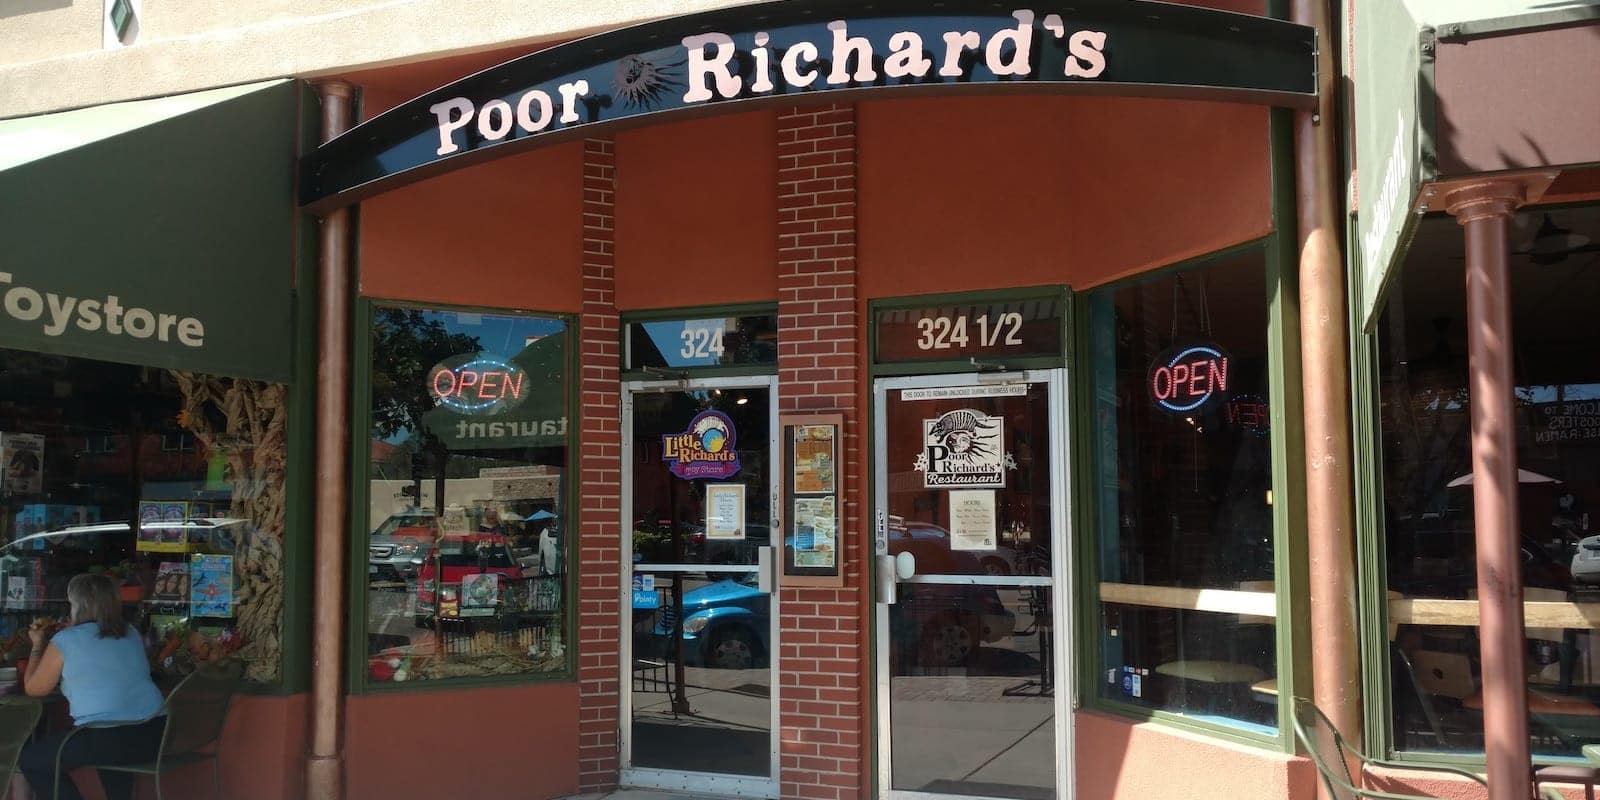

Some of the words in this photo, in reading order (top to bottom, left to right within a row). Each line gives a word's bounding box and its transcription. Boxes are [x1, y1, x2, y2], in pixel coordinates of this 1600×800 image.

[430, 80, 589, 156] Poor
[682, 9, 1107, 103] Richard's
[681, 327, 725, 359] 324
[917, 316, 969, 350] 324
[976, 312, 1023, 347] 1/2
[433, 369, 523, 399] OPEN
[1153, 357, 1228, 400] OPEN
[665, 434, 702, 457] Little
[680, 447, 736, 463] Richard's
[927, 445, 967, 473] Poor
[928, 473, 1001, 485] Restaurant
[943, 460, 995, 473] Richard's
